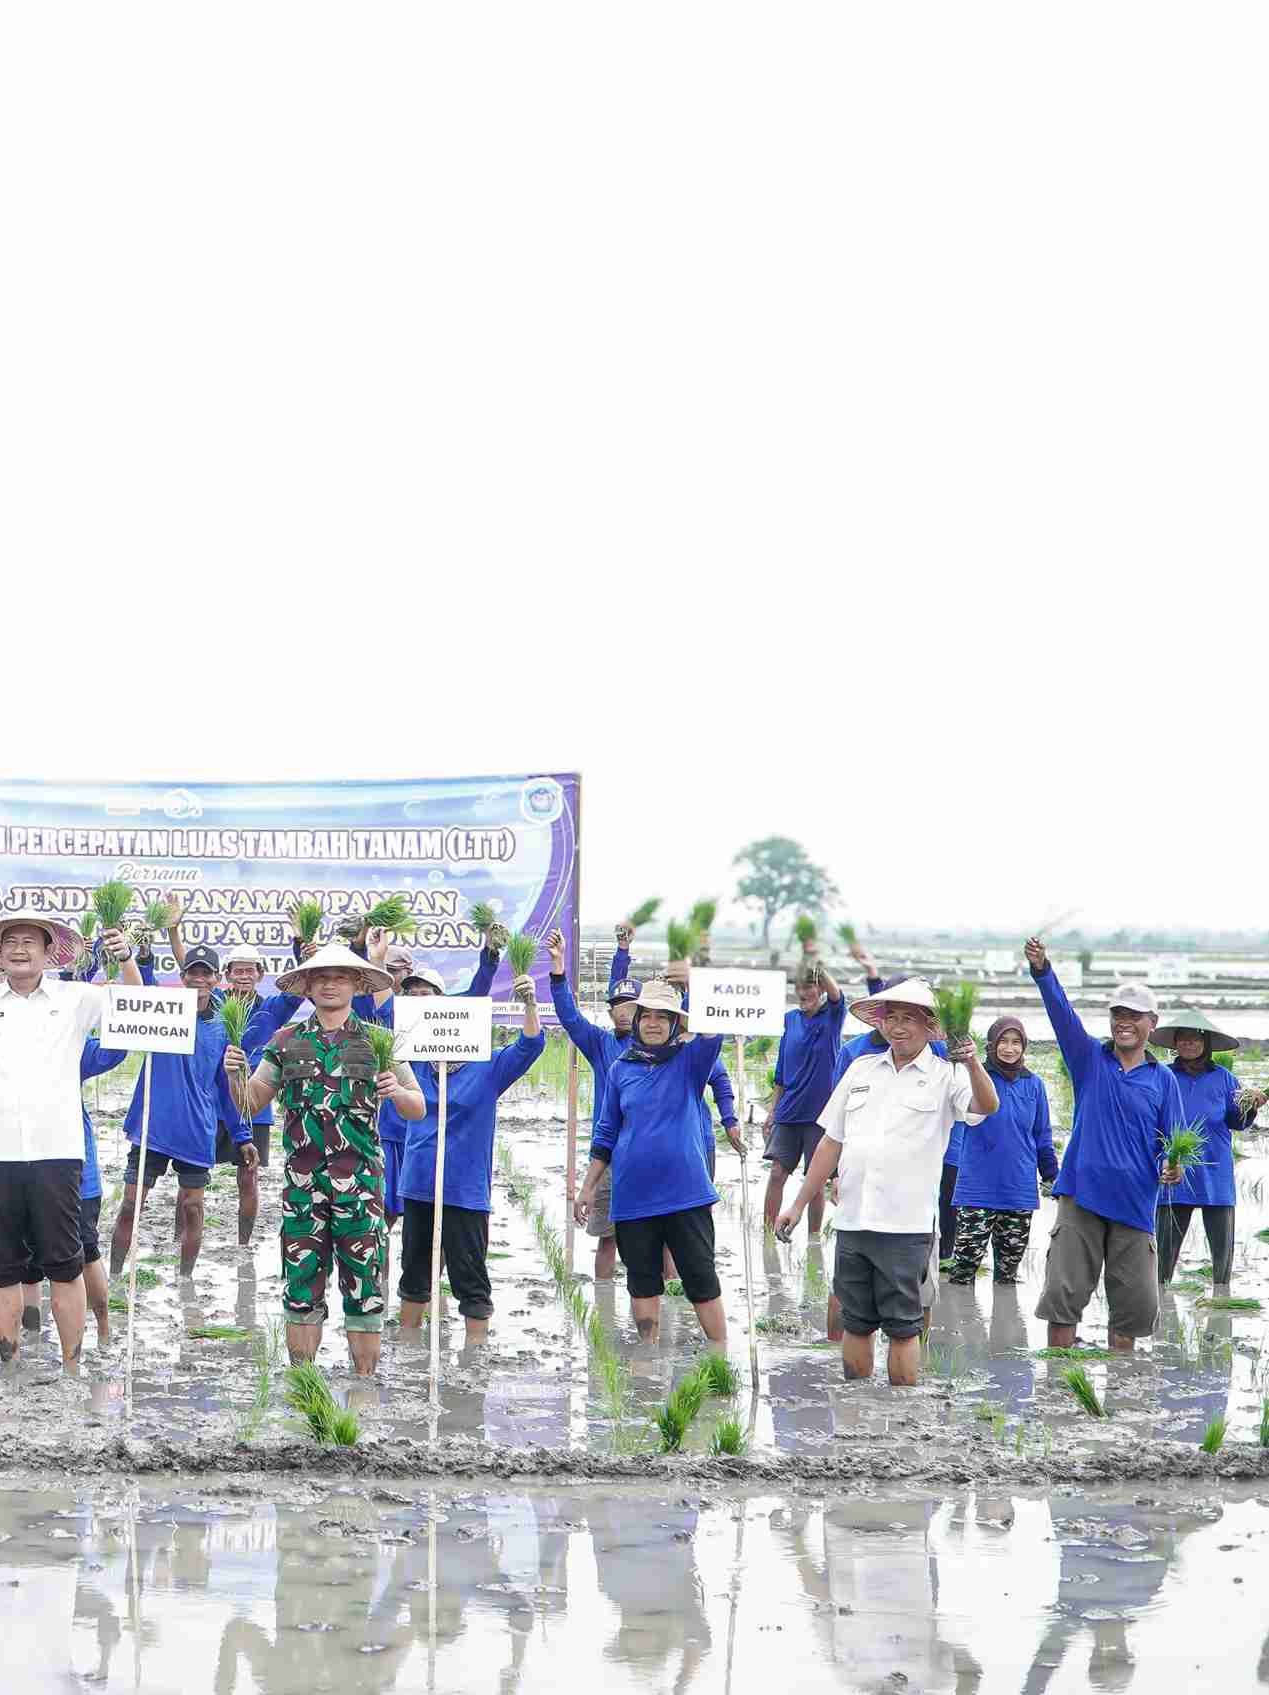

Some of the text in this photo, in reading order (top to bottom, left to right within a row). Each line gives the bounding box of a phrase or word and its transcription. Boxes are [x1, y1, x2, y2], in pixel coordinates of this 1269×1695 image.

[10, 826, 169, 857] PERCEPATAN
[171, 828, 239, 858] LUAS
[240, 829, 349, 859] TAMBAH
[351, 829, 443, 860] TANAM
[446, 827, 516, 862] (LTT)
[116, 862, 199, 881] Bersama
[713, 984, 761, 996] KADIS
[116, 998, 183, 1015] BUPATI
[706, 1006, 766, 1018] Din KPP
[424, 1011, 469, 1020] DANDIM
[108, 1023, 189, 1038] LAMONGAN
[433, 1028, 460, 1037] 0812
[413, 1044, 479, 1054] LAMONGAN
